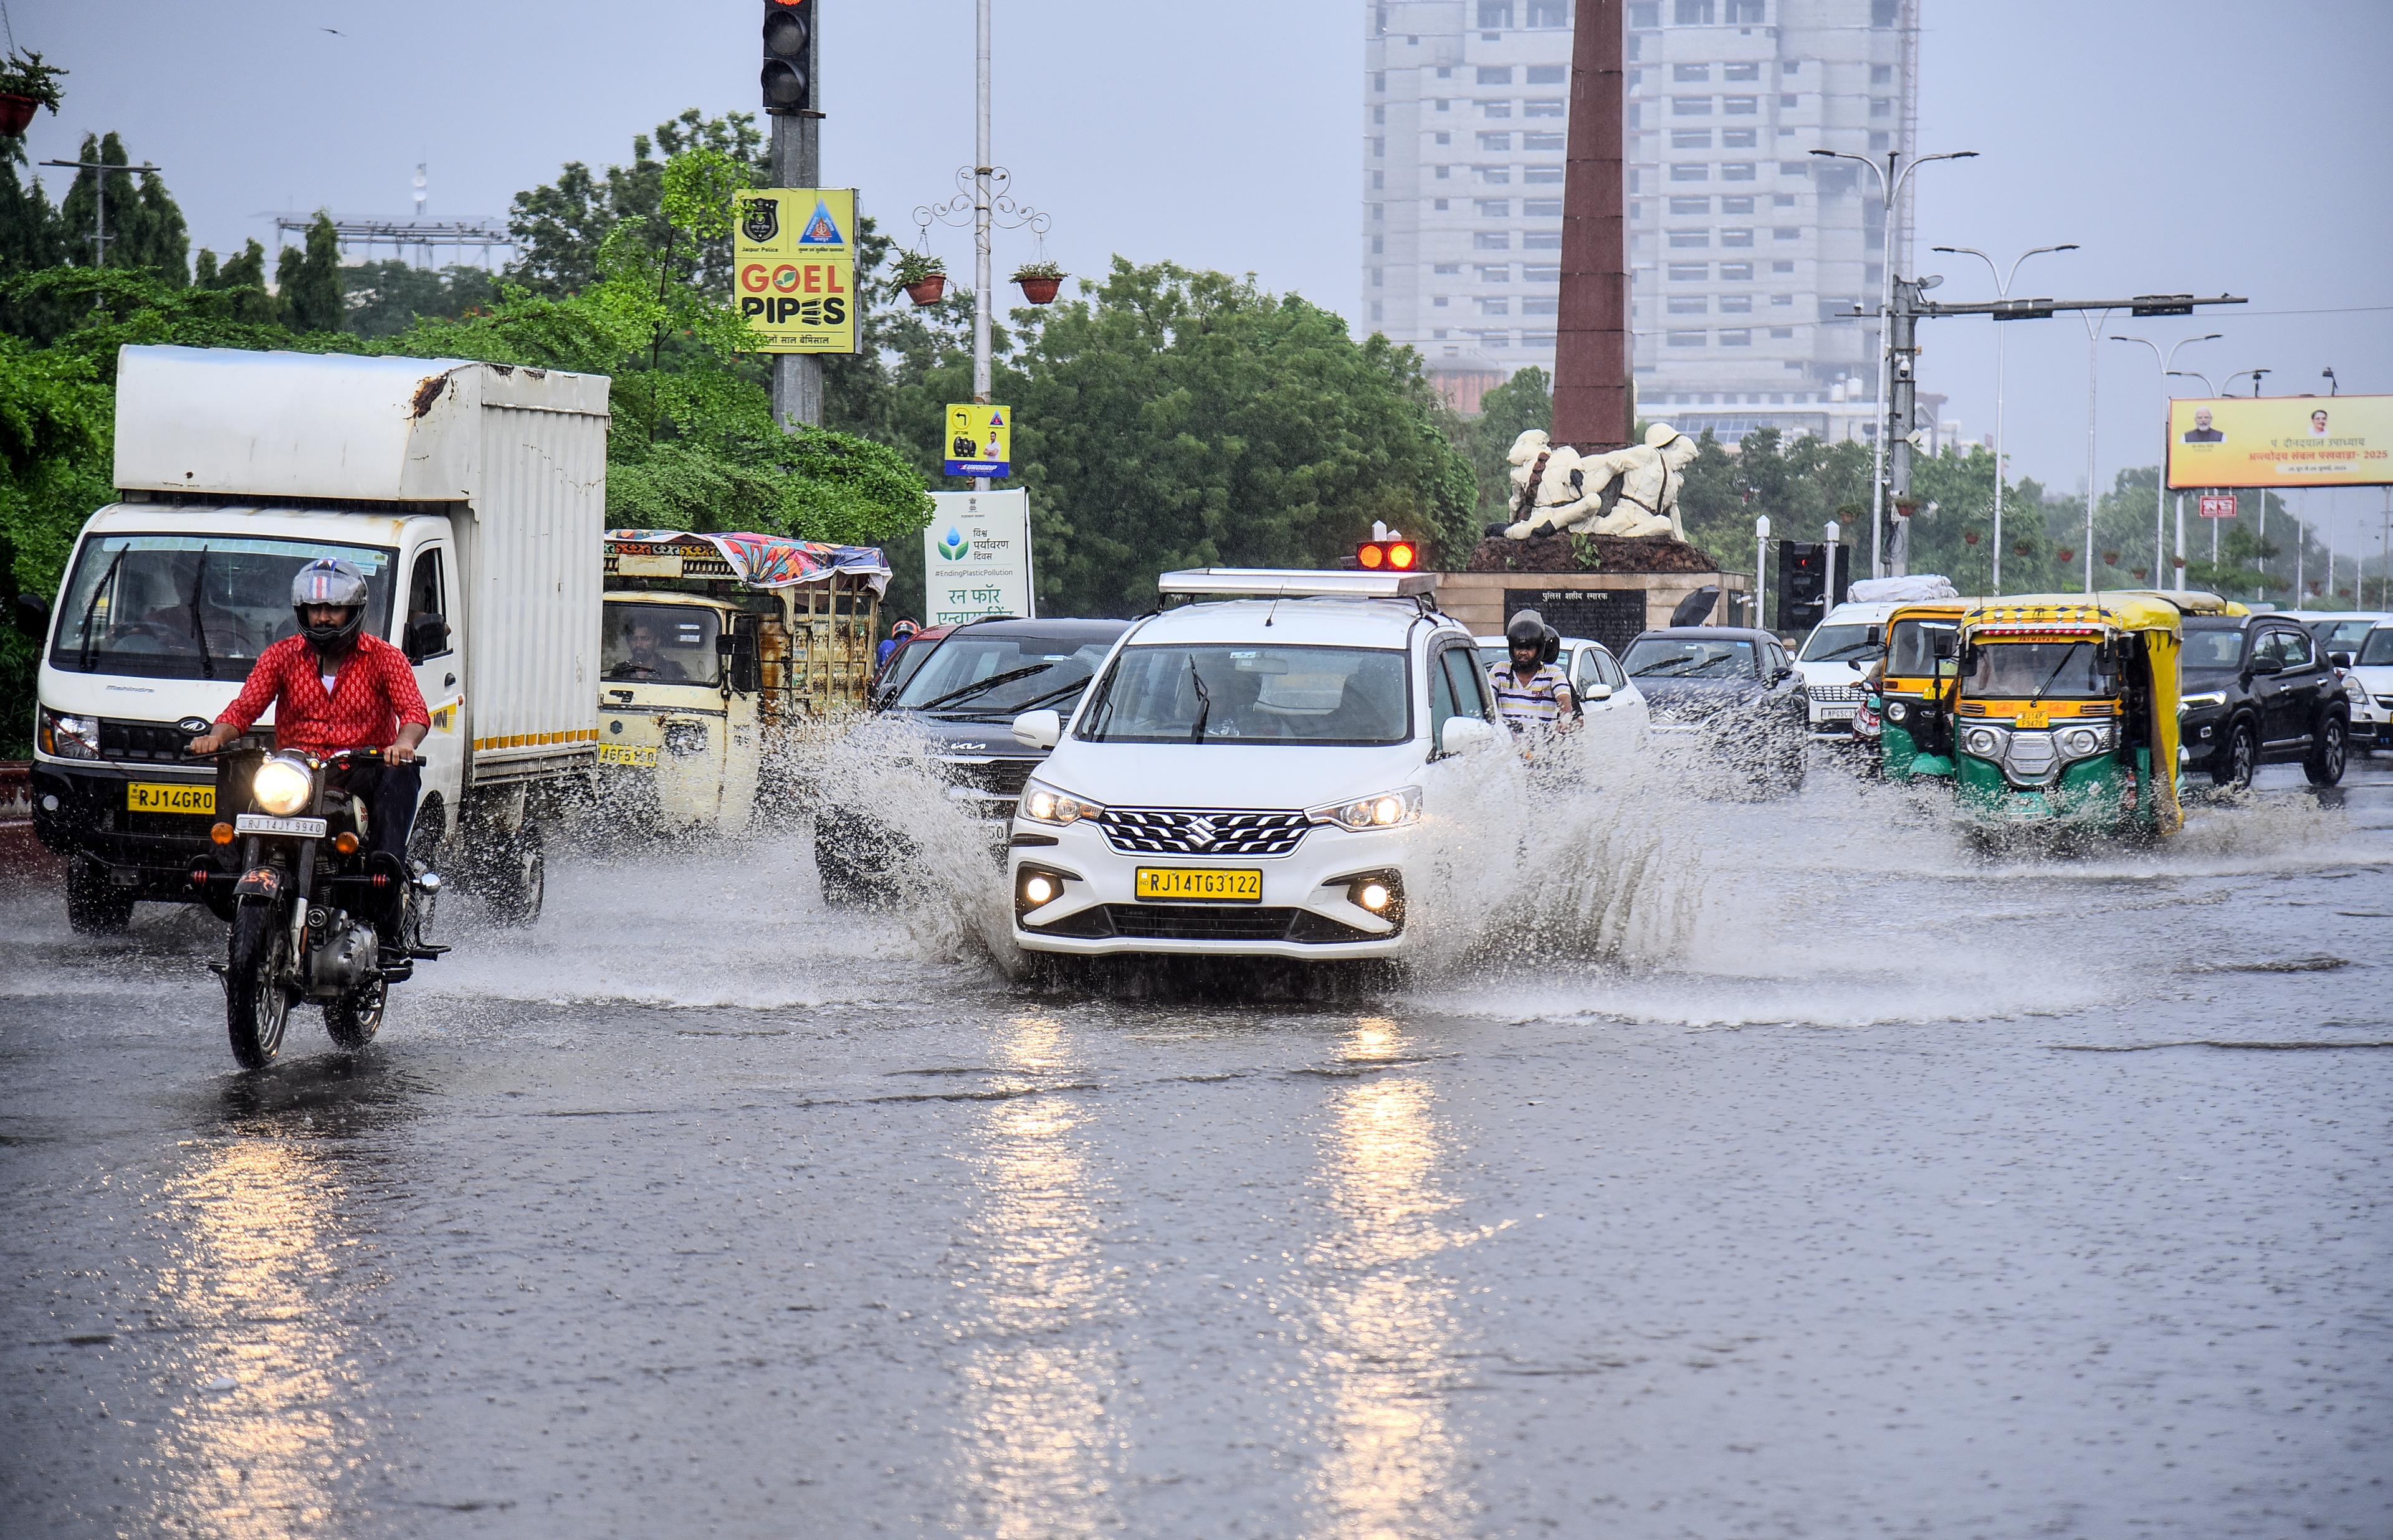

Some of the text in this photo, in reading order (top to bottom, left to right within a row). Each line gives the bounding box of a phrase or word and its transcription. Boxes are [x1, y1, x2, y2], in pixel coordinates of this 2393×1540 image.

[742, 264, 844, 293] GOEL
[742, 297, 846, 326] PIPES
[799, 335, 829, 344] बेमिसाल
[2364, 450, 2388, 459] 2025
[973, 528, 988, 537] विश्व
[973, 538, 1009, 549] पर्यावरण
[974, 551, 992, 560] दिवस
[935, 569, 1013, 578] #EndingPlasticPollution
[948, 584, 1001, 604] रन फॉर
[1542, 591, 1561, 602] पुलिस
[1587, 592, 1608, 601] स्मारक
[249, 820, 321, 832] RJ 14JY 9940
[1150, 874, 1257, 893] RJ14TG3122
